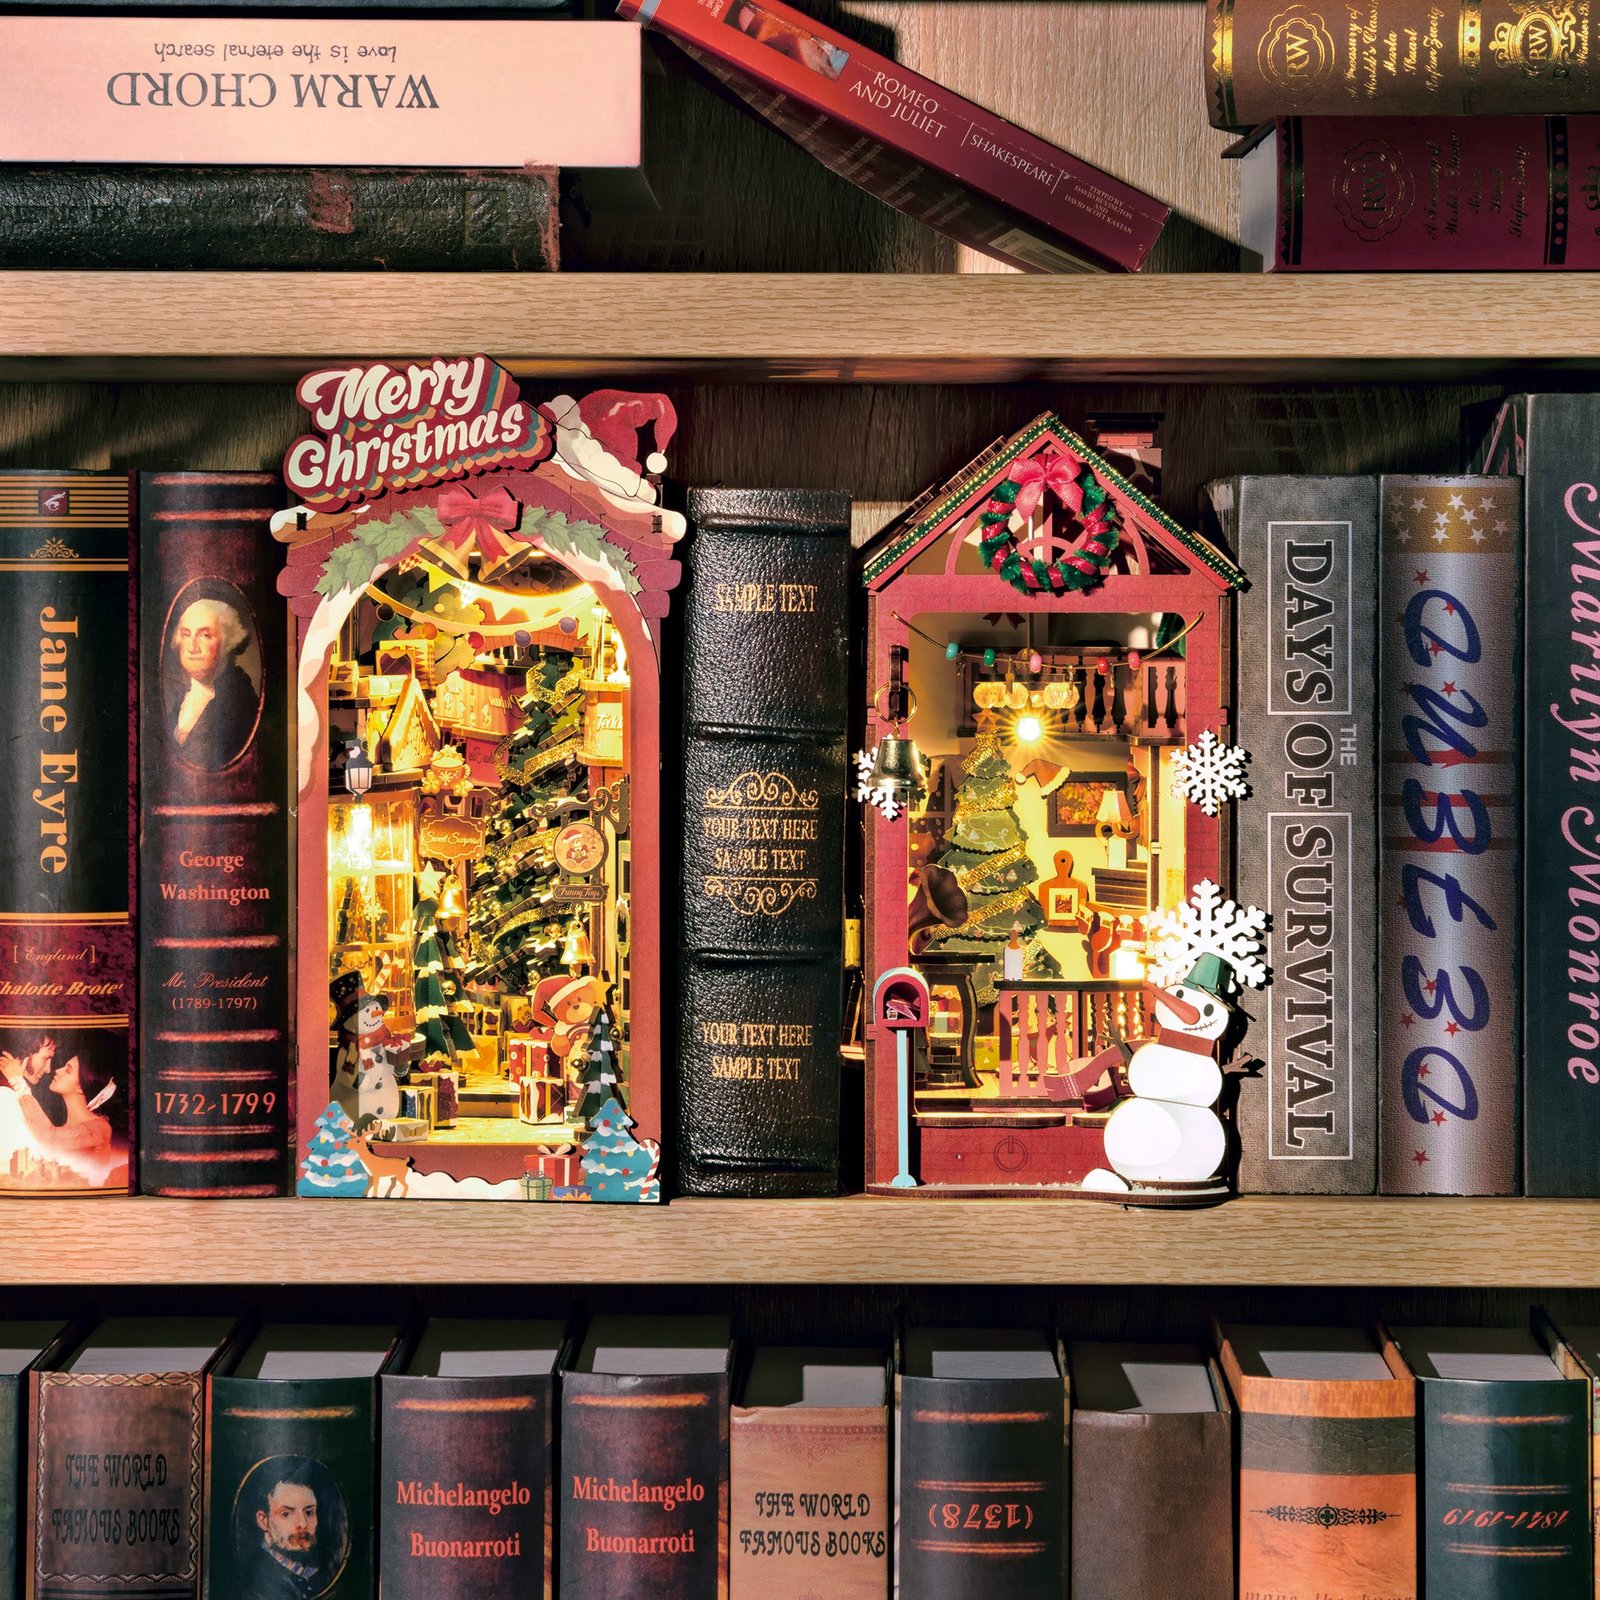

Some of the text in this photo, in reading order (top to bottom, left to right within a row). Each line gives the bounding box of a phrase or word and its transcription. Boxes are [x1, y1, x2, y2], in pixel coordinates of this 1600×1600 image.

[1345, 4, 1363, 20] of
[154, 42, 397, 65] Love is the eternal search
[1285, 31, 1310, 78] RW
[1529, 25, 1547, 61] RW
[107, 72, 440, 109] WARM CHORD
[872, 71, 939, 115] ROMEO
[849, 80, 947, 139] AND JULIET
[970, 134, 1055, 186] SHAKESPEARE
[1362, 163, 1388, 211] RW
[300, 356, 486, 431] Merry
[288, 402, 524, 488] Christmas
[715, 583, 817, 612] SAMPLE TEXT
[33, 606, 79, 873] Jane Eyre
[703, 816, 818, 840] YOUR TEXT HERE
[1284, 540, 1356, 1149] DAYS OF THE SURVIVAL
[179, 851, 244, 873] George
[715, 848, 806, 870] SAMPLE TEXT
[160, 883, 271, 906] Washington
[162, 971, 269, 989] Mr. President
[172, 996, 258, 1011] (1789-1797)
[702, 1022, 813, 1047] YOUR TEXT HERE
[712, 1056, 801, 1080] SAMPLE TEXT
[154, 1091, 276, 1116] 1732-1799
[65, 1453, 168, 1491] THE WORLD
[396, 1480, 531, 1514] Michelangelo
[572, 1475, 705, 1512] Michelangelo
[755, 1492, 870, 1520] THE WORLD
[51, 1508, 181, 1547] FAMOUS BOOKS
[928, 1503, 1034, 1529] (1378)
[1442, 1507, 1571, 1531] 1841-1919
[410, 1532, 521, 1558] Buonarroti
[586, 1527, 695, 1554] Buonarroti
[739, 1530, 886, 1557] FAMOUS BOOKS
